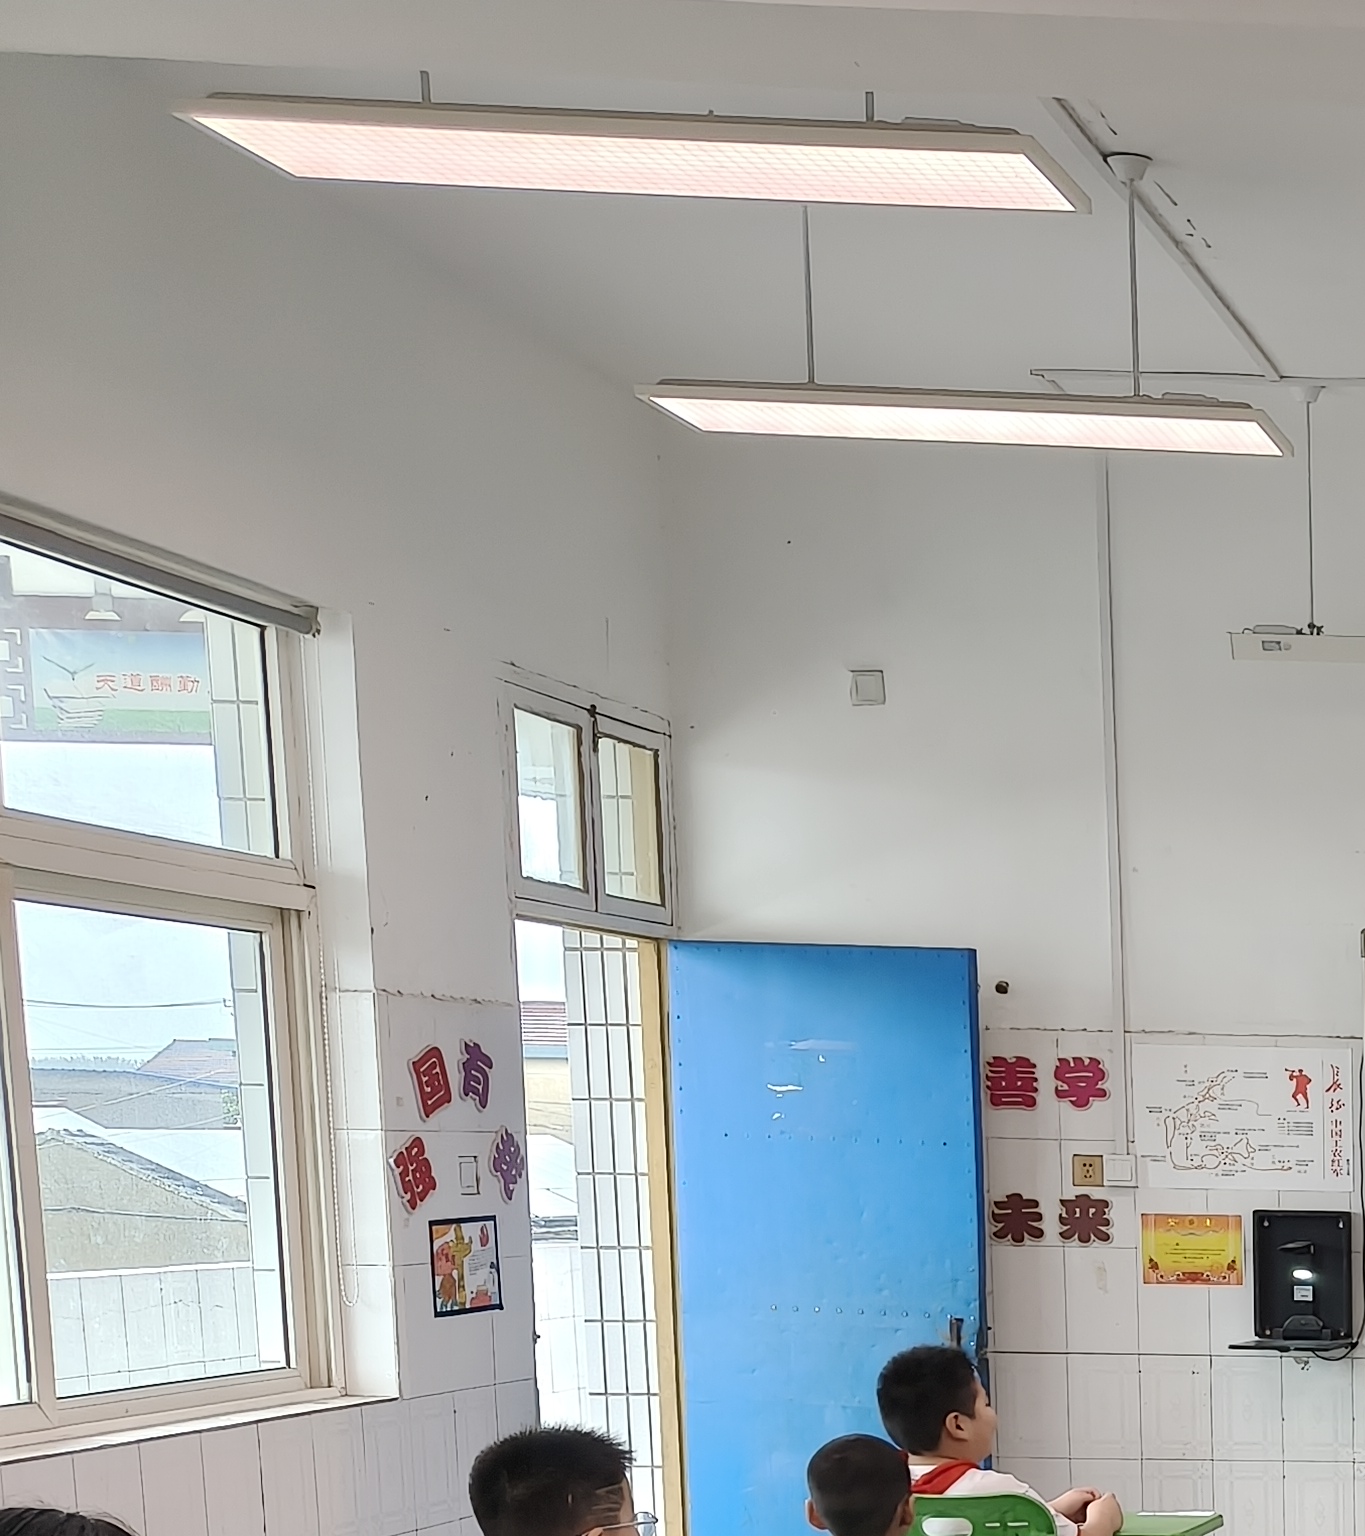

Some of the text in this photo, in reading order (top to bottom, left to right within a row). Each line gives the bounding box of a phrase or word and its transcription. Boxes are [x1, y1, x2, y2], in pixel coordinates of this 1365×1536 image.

[95, 673, 201, 694] 天道酬勤
[986, 1056, 1109, 1109] 善学
[991, 1193, 1113, 1245] 未来
